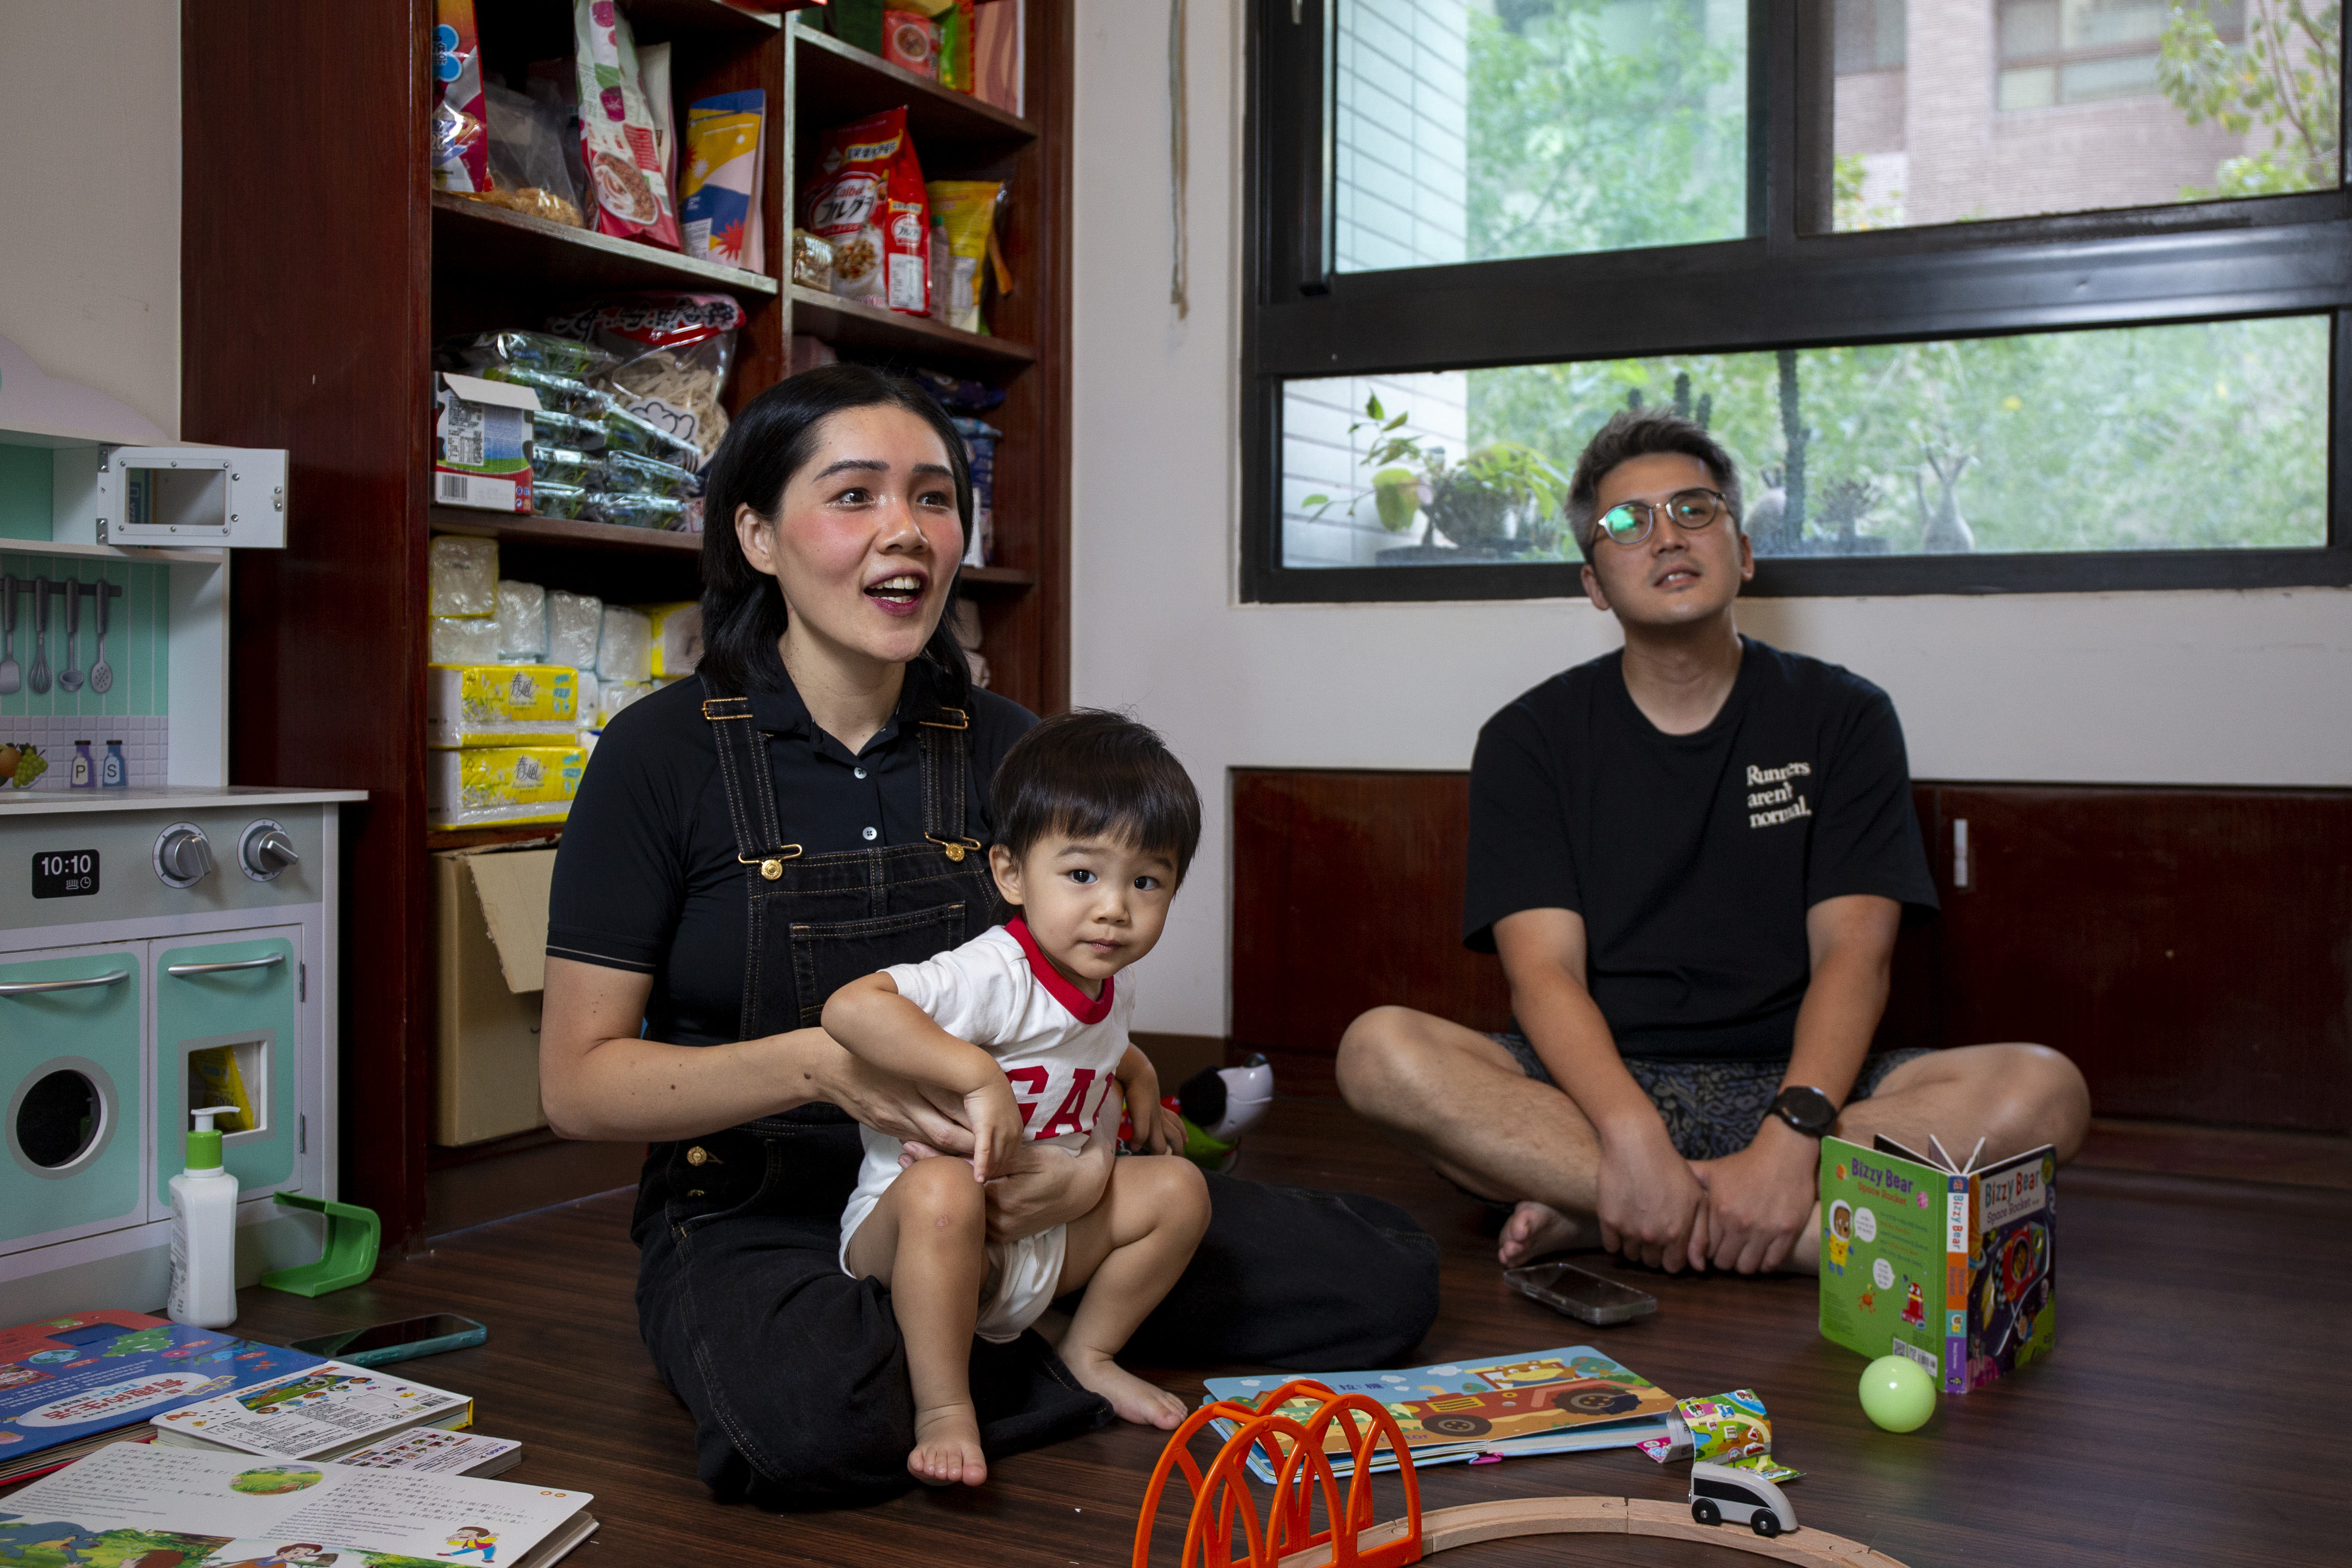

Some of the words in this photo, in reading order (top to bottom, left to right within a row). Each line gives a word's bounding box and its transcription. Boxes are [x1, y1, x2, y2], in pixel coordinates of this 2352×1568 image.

[75, 764, 86, 778] P
[107, 764, 117, 777] S
[1746, 762, 1812, 787] Runners
[1749, 794, 1813, 829] normal.
[42, 854, 91, 876] 10:10
[1005, 1065, 1115, 1141] GA
[1852, 1157, 1883, 1187] Bizzy
[1886, 1168, 1914, 1194] Bear
[1985, 1179, 2014, 1209] Bizzy
[2016, 1170, 2041, 1196] Bear
[1951, 1194, 1964, 1224] Bizzy
[1951, 1224, 1964, 1249] Bear
